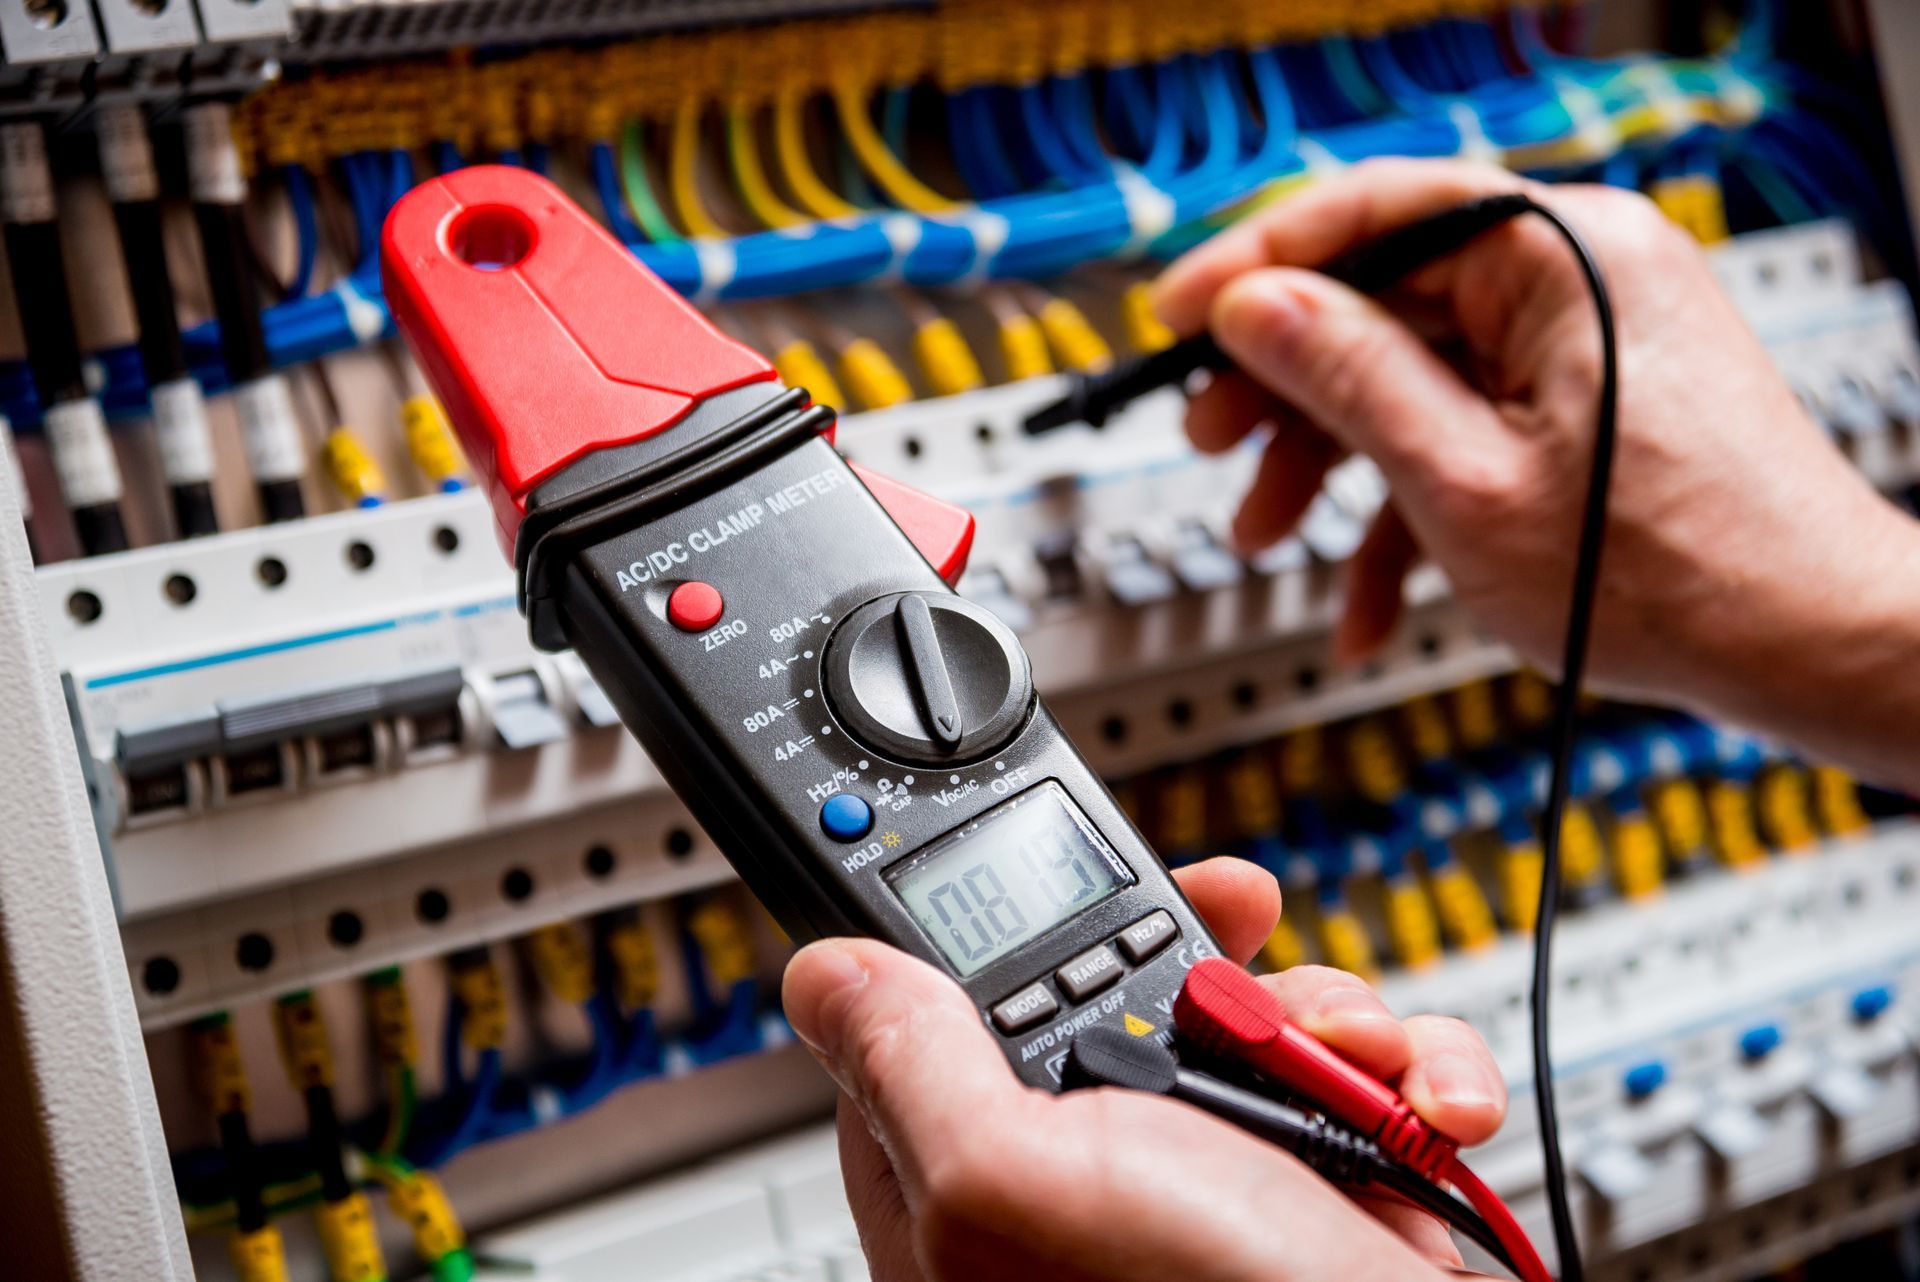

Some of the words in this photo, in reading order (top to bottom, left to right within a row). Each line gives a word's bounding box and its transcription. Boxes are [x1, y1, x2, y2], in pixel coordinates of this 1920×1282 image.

[615, 543, 688, 592] AC/DC
[688, 504, 764, 553] CLAMP
[765, 467, 848, 514] METER
[699, 619, 748, 652] ZERO
[806, 767, 859, 803] Hz/%
[990, 766, 1030, 795] OFF
[891, 795, 913, 812] CAP
[842, 842, 884, 874] HOLD
[1131, 909, 1169, 943] Hz/%
[1070, 953, 1115, 986] RANGE
[1006, 989, 1047, 1021] MODE
[1021, 1032, 1055, 1063] AUTO
[1054, 1006, 1102, 1041] POWER
[1101, 990, 1126, 1014] OFF
